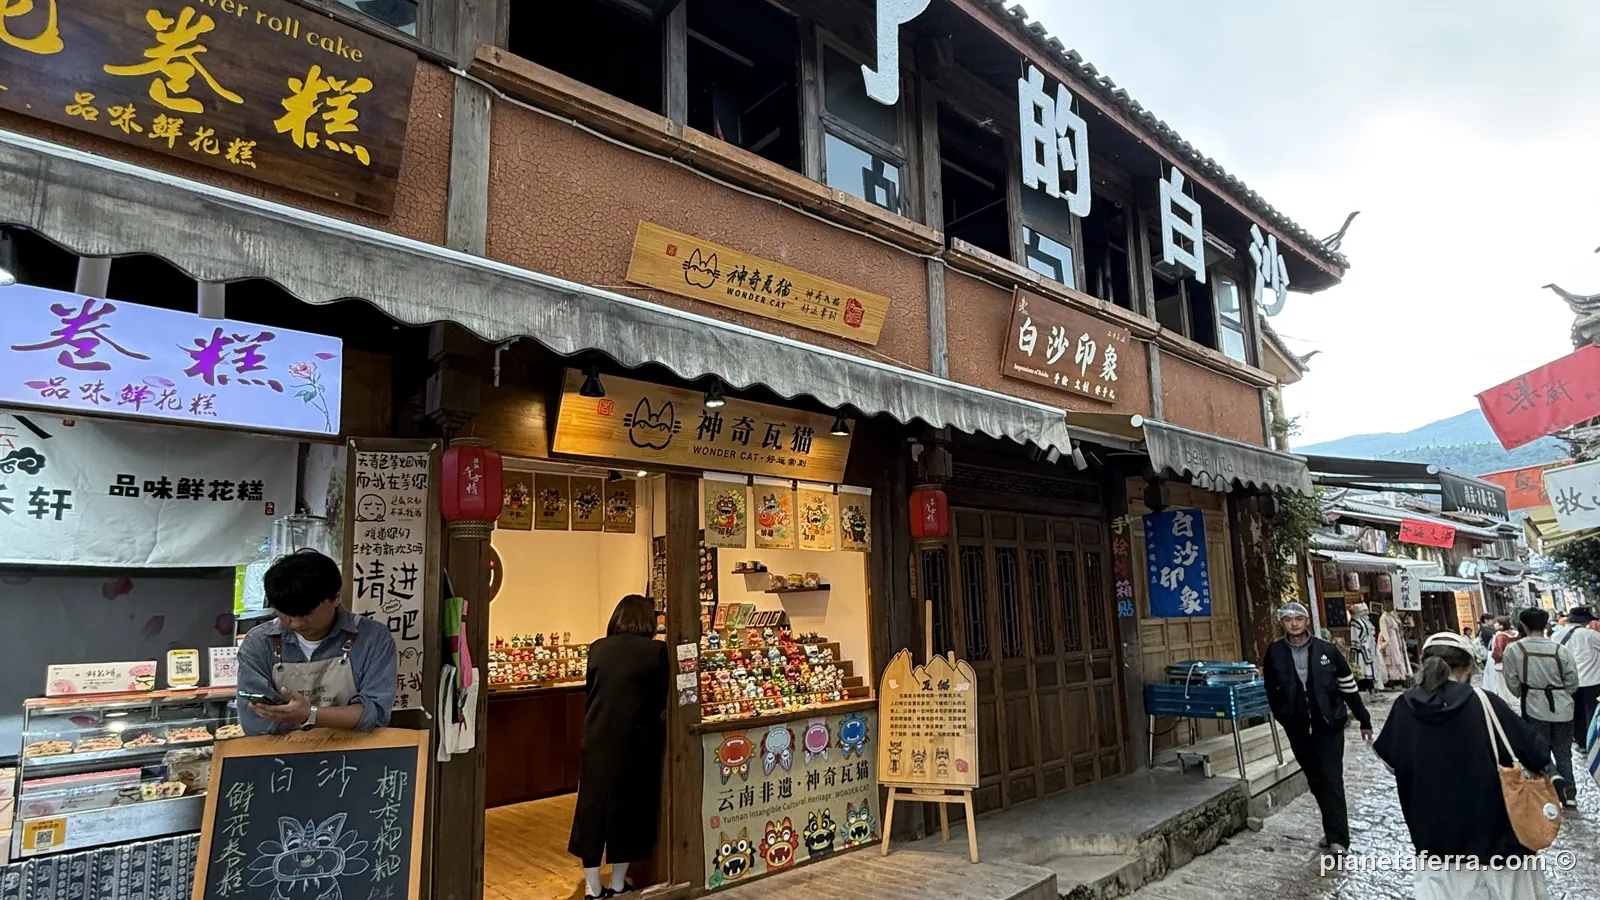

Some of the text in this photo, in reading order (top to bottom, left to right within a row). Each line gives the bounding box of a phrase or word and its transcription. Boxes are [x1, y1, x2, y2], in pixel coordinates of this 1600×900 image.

[256, 10, 300, 39] roll
[306, 31, 363, 62] cake
[65, 91, 257, 169] 品味鲜花糕
[726, 264, 793, 297] 神奇瓦猫
[726, 287, 787, 310] WONDER CAT
[10, 298, 284, 392] 卷糕
[1019, 316, 1118, 381] 白沙印象
[39, 376, 218, 418] 品味鲜花糕
[693, 445, 759, 462] WONDER CAT
[696, 410, 815, 455] 神奇瓦猫
[356, 471, 428, 491] 而我在等你
[357, 453, 427, 470] 天青色等烟雨
[109, 473, 265, 502] 品味鲜花糕
[364, 526, 411, 541] 难道你们
[354, 558, 419, 606] 请进
[1110, 516, 1134, 617] 手绘冰箱贴
[1160, 510, 1203, 614] 白沙印象
[270, 755, 358, 798] 白沙
[717, 760, 869, 813] 云南非遗·神奇瓦猫
[722, 784, 870, 824] Yunnan Intangible Cultural Heritage WONDER CAT
